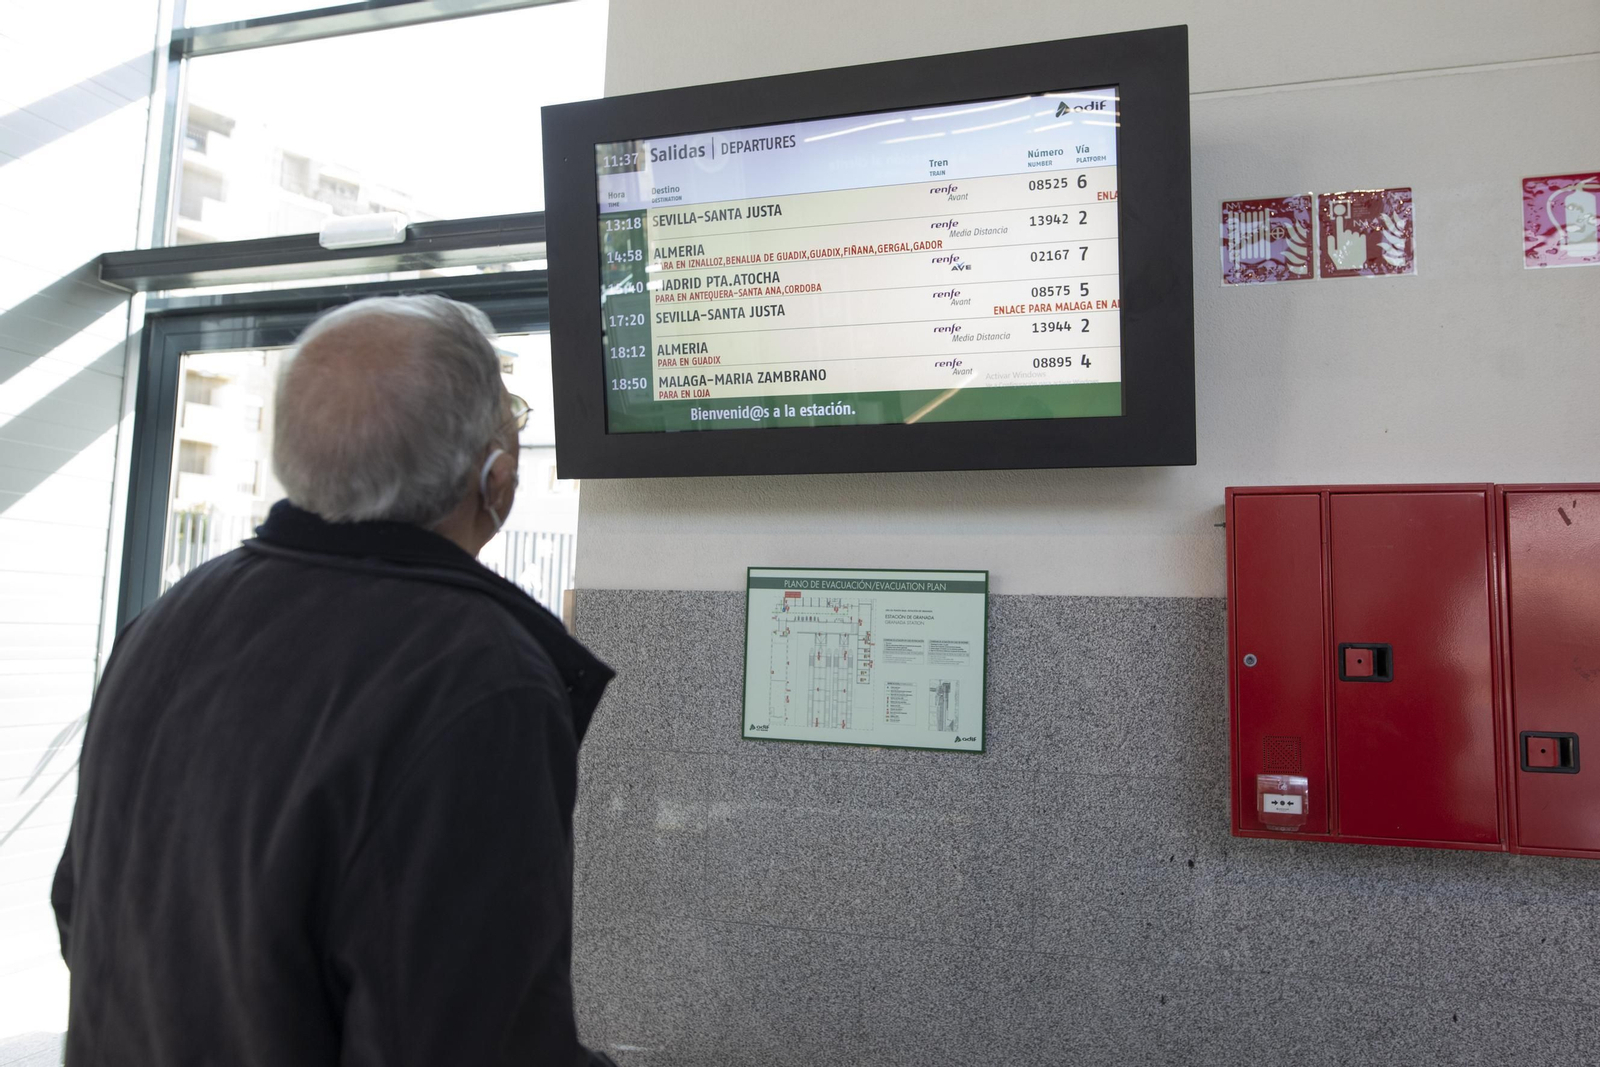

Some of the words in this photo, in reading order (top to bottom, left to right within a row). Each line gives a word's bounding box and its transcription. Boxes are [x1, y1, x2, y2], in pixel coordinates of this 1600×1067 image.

[650, 144, 706, 163] Salidas
[721, 135, 796, 155] DEPARTURES
[1028, 148, 1064, 158] Número
[1075, 144, 1090, 154] Vía
[603, 152, 639, 168] 11:37
[929, 159, 949, 168] Tren
[1028, 160, 1053, 168] NUMBER
[1076, 155, 1107, 164] PLATFORM
[1028, 177, 1068, 191] 08525
[1077, 174, 1087, 189] 6
[652, 186, 680, 195] Destino
[929, 183, 958, 195] renfe
[608, 192, 625, 200] Hora
[652, 195, 682, 204] DESTINATION
[948, 193, 969, 201] Avant
[652, 207, 742, 227] SEVILLA-SANTA
[746, 204, 782, 219] JUSTA
[1029, 213, 1068, 227] 13942
[1079, 210, 1087, 225] 2
[605, 217, 642, 232] 13:18
[930, 218, 959, 230] renfe
[949, 229, 972, 238] Media
[973, 226, 1008, 236] Distancia
[606, 249, 643, 264] 14:58
[653, 243, 705, 259] ALMERIA
[676, 259, 686, 269] EN
[688, 254, 761, 268] IZNALLOZ,BENALUA
[763, 253, 774, 262] DE
[776, 239, 943, 262] GUADIX,GUADIX,FIÑANA,GERGAL,GADOR
[1030, 249, 1069, 262] 02167
[1079, 246, 1088, 261] 7
[931, 253, 960, 265] renfe
[951, 262, 972, 271] AVE
[706, 271, 780, 288] PTA.ATOCHA
[655, 294, 675, 303] PARA
[677, 292, 687, 302] EN
[689, 287, 763, 301] ANTEQUERA-SANTA
[765, 283, 822, 296] ANA,CORDOBA
[932, 288, 961, 300] renfe
[1031, 285, 1070, 298] 08575
[1080, 282, 1089, 297] 5
[950, 298, 971, 306] Avant
[993, 304, 1025, 315] ENLACE
[1028, 303, 1052, 313] PARA
[1055, 301, 1093, 312] MALAGA
[1096, 300, 1107, 309] EN
[609, 313, 645, 327] 17:20
[656, 307, 745, 324] SEVILLA-SANTA
[749, 304, 785, 318] JUSTA
[933, 323, 962, 335] renfe
[1032, 321, 1071, 333] 13944
[1081, 318, 1090, 333] 2
[951, 333, 974, 342] Media
[976, 331, 1011, 341] Distancia
[610, 345, 646, 359] 18:12
[657, 342, 708, 356] ALMERIA
[657, 358, 677, 367] PARA
[680, 357, 689, 366] EN
[692, 356, 721, 366] GUADIX
[934, 358, 963, 369] renfe
[1032, 356, 1072, 369] 08895
[1081, 354, 1091, 369] 4
[658, 372, 754, 388] MALAGA-MARIA
[757, 368, 827, 384] ZAMBRANO
[952, 367, 973, 376] Avant
[611, 377, 647, 391] 18:50
[658, 390, 678, 399] PARA
[681, 389, 691, 398] EN
[693, 389, 710, 398] LOJA
[690, 405, 770, 422] Bienvenid@s
[773, 408, 780, 418] a
[784, 404, 795, 417] la
[799, 400, 856, 417] estación.
[784, 580, 808, 589] PLANO
[810, 580, 820, 589] DE
[822, 579, 925, 591] EVACUACIÓN/EVACUATION
[927, 582, 946, 591] PLAN
